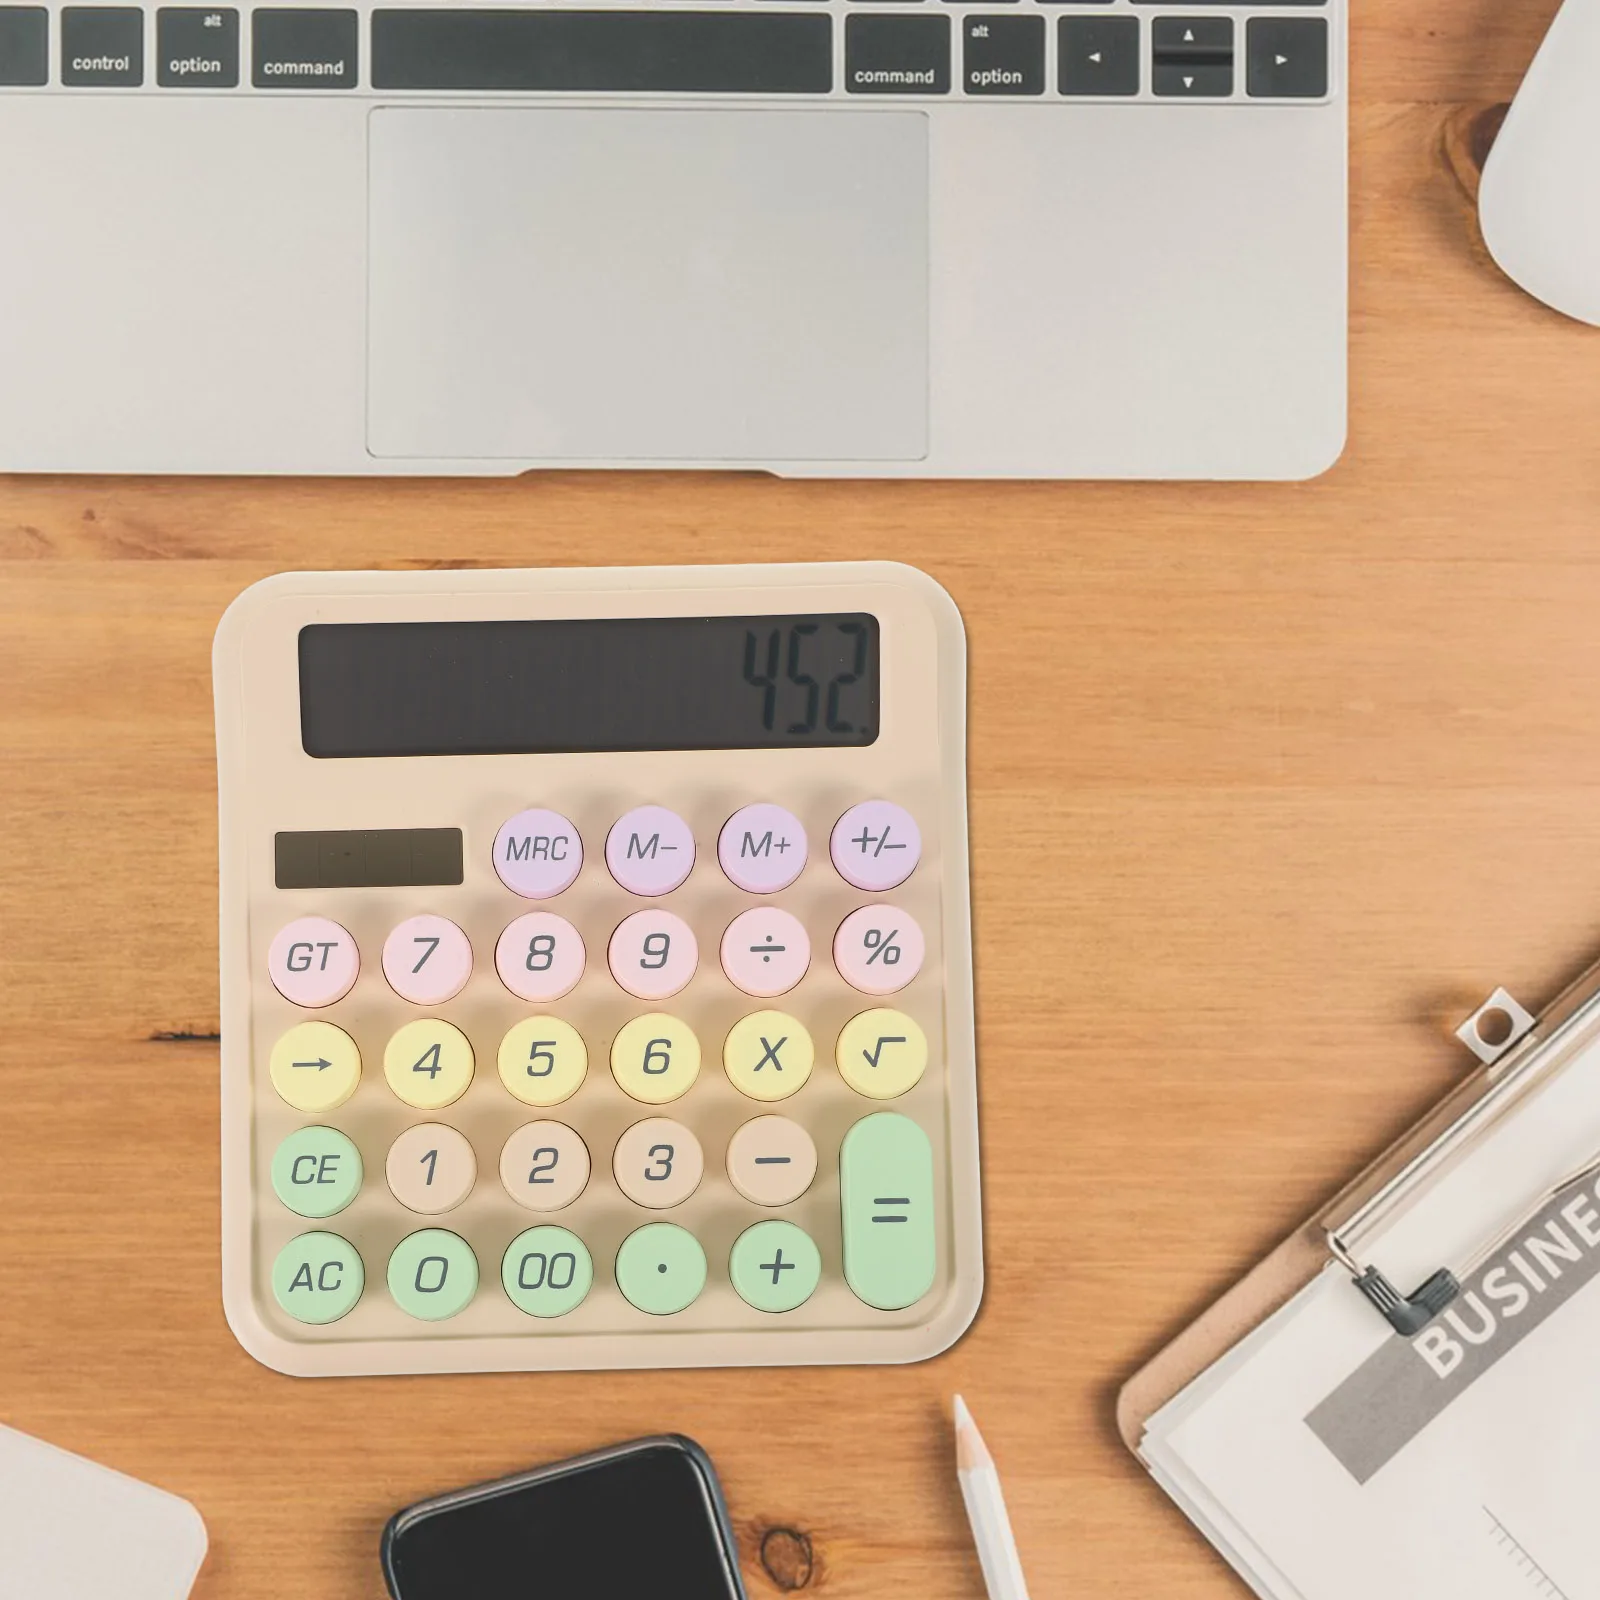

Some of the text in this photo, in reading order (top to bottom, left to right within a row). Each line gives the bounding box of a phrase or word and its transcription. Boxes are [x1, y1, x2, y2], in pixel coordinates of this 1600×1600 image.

[972, 25, 988, 37] alt
[72, 56, 129, 71] control
[170, 57, 221, 75] option
[264, 60, 344, 75] command
[855, 69, 934, 83] command
[971, 68, 1022, 86] option
[507, 836, 568, 861] MRC
[741, 832, 790, 857] M+
[287, 943, 338, 971] GT
[412, 938, 439, 973] 7
[526, 933, 555, 972] 8
[640, 932, 670, 968] 9
[413, 1044, 441, 1079] 4
[527, 1041, 556, 1076] 5
[643, 1039, 671, 1074] 6
[291, 1155, 340, 1184] CE
[420, 1150, 437, 1185] 1
[528, 1148, 558, 1183] 2
[645, 1145, 674, 1180] 3
[289, 1262, 343, 1292] AC
[415, 1256, 448, 1292] 0
[518, 1252, 575, 1289] 00
[1412, 1176, 1600, 1380] BUSINE
